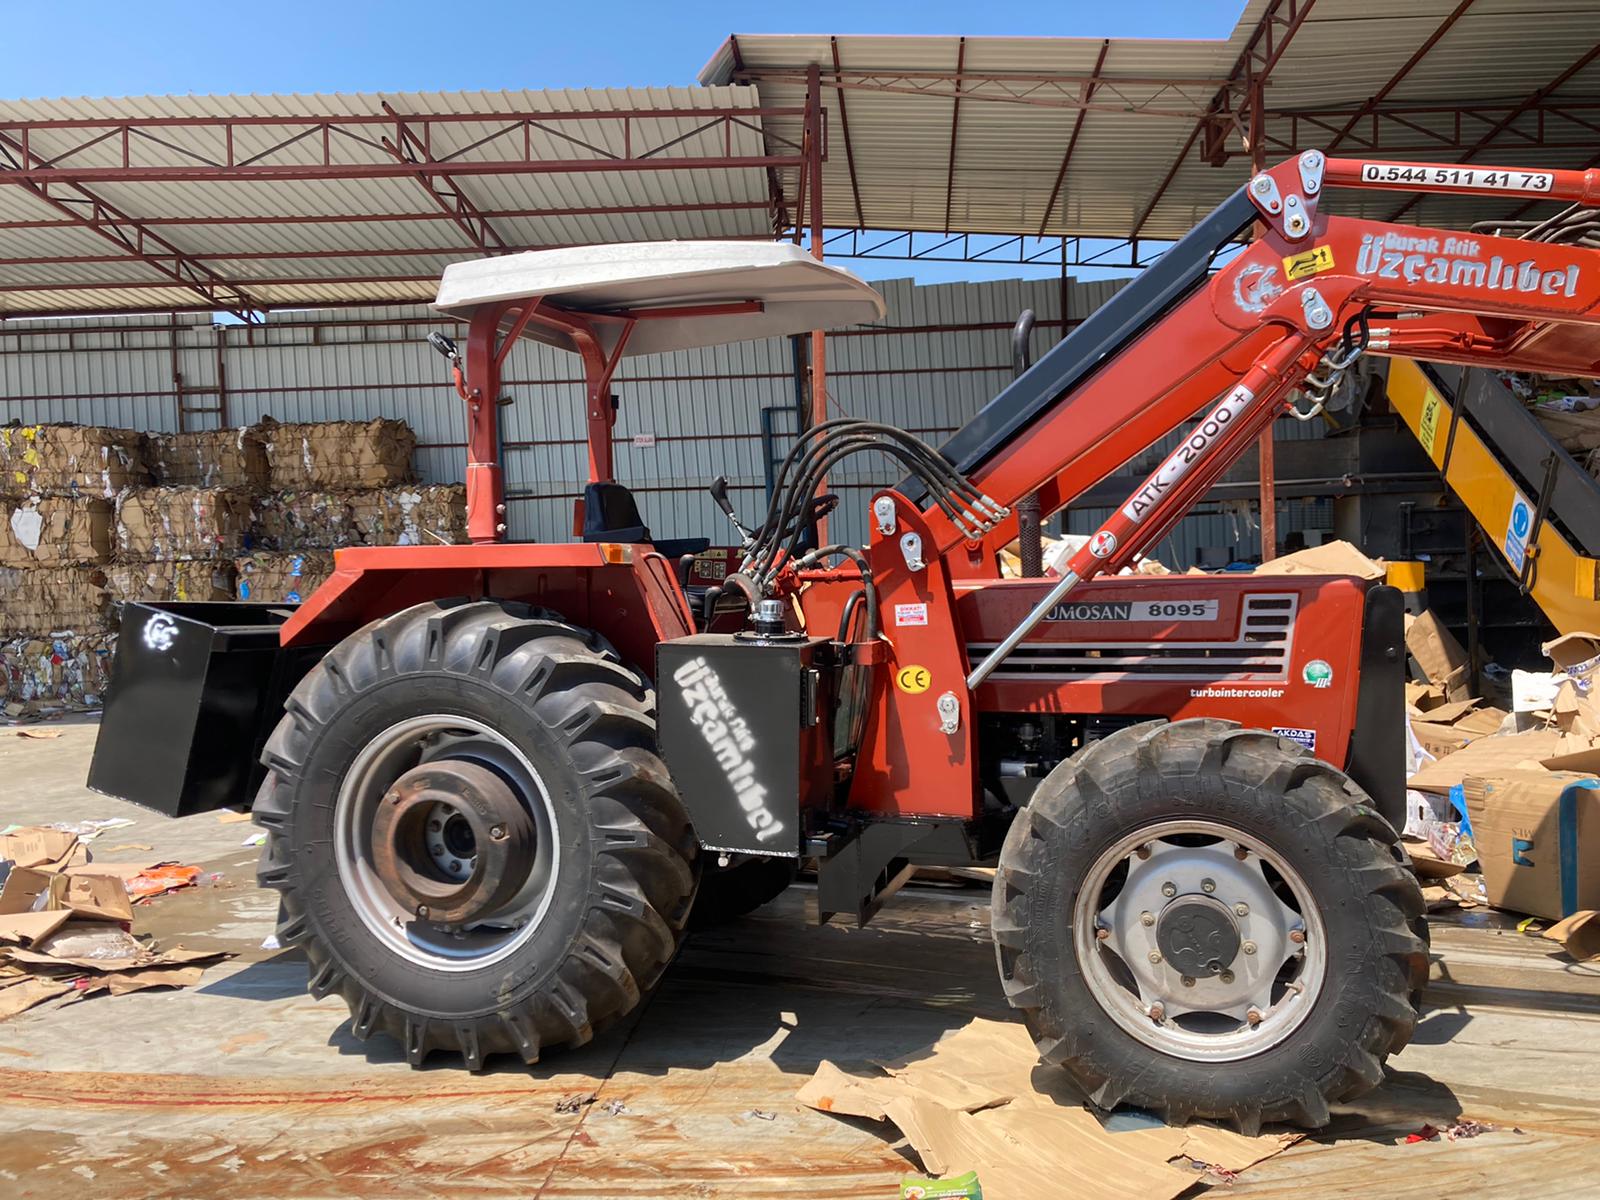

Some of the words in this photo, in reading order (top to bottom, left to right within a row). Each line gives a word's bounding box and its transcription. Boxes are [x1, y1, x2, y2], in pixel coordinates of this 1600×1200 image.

[1366, 166, 1427, 182] 0.544
[1434, 170, 1475, 185] 511
[1483, 172, 1510, 188] 41
[1520, 174, 1548, 189] 73
[1131, 474, 1171, 517] ATK
[1177, 408, 1232, 464] 2000
[1046, 605, 1129, 621] UMOSAN
[1148, 604, 1206, 617] 8095
[900, 670, 926, 689] CE
[1190, 687, 1284, 698] turbointercooler
